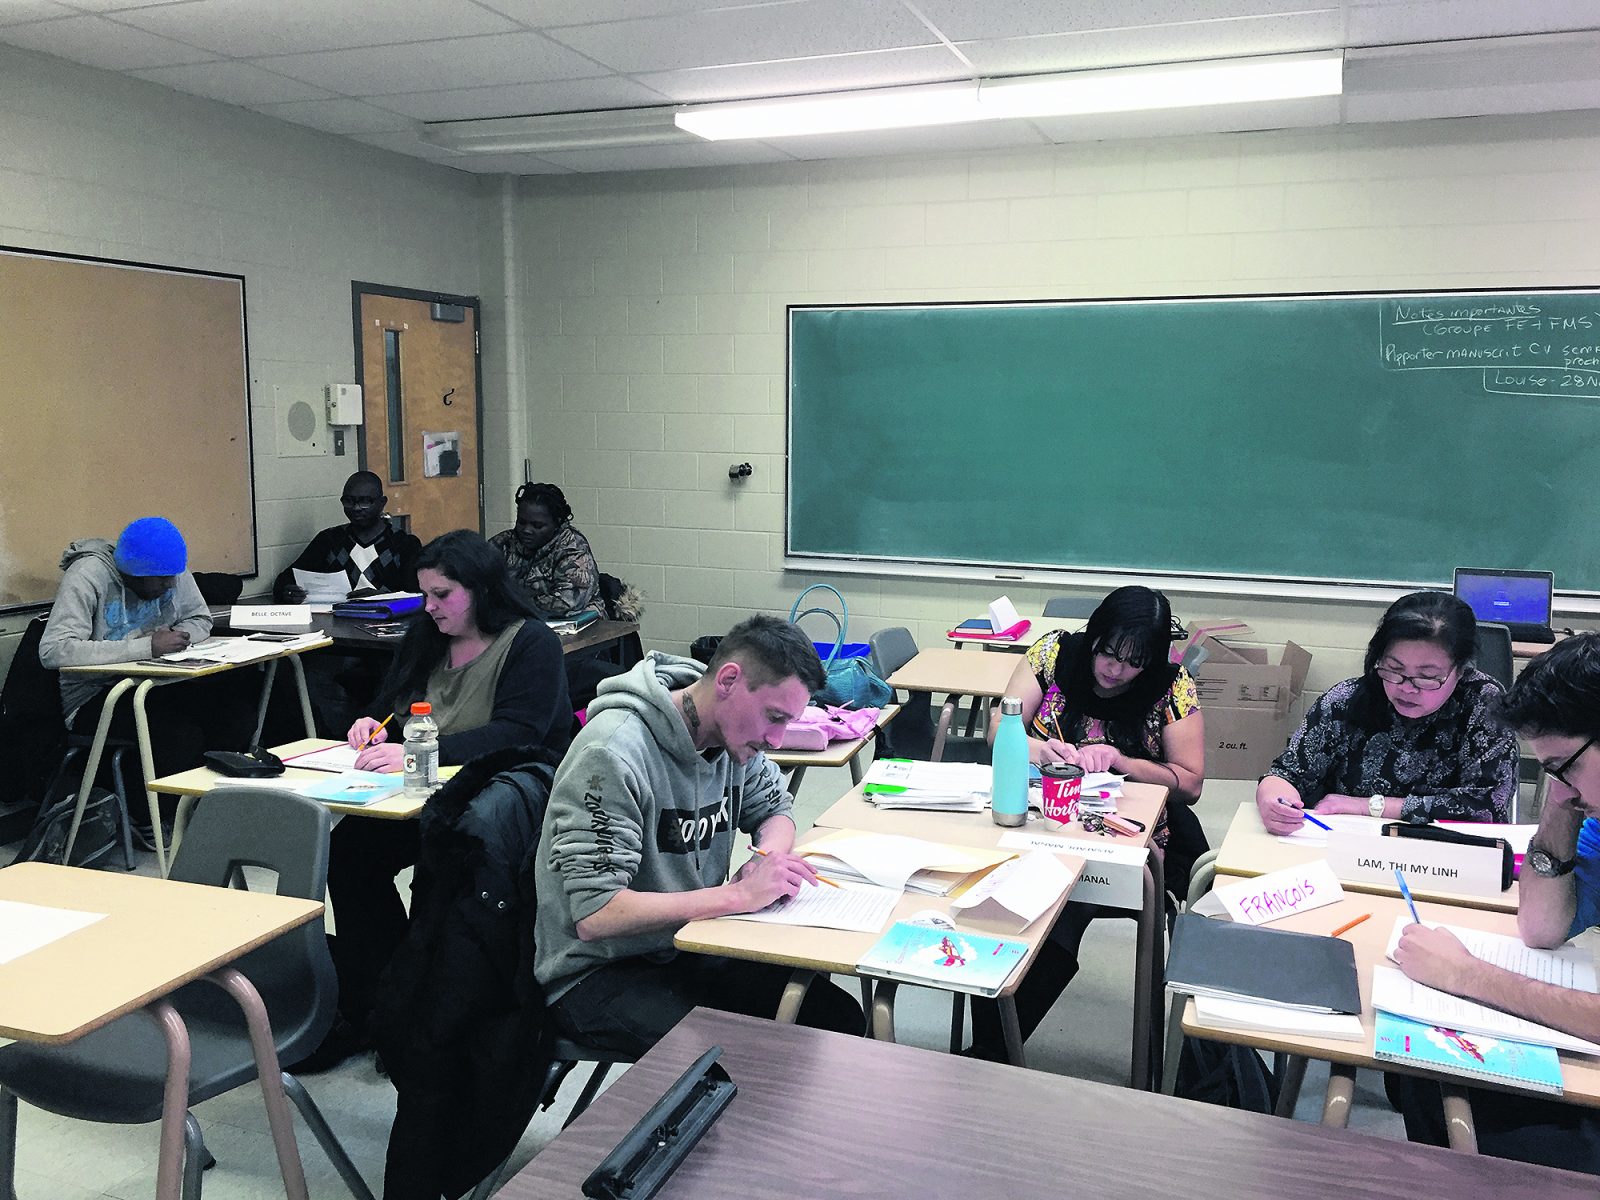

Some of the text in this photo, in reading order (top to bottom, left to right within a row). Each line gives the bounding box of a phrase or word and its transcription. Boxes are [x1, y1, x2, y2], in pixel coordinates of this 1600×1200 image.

[1357, 857, 1458, 878] LAM, THI MY LINH
